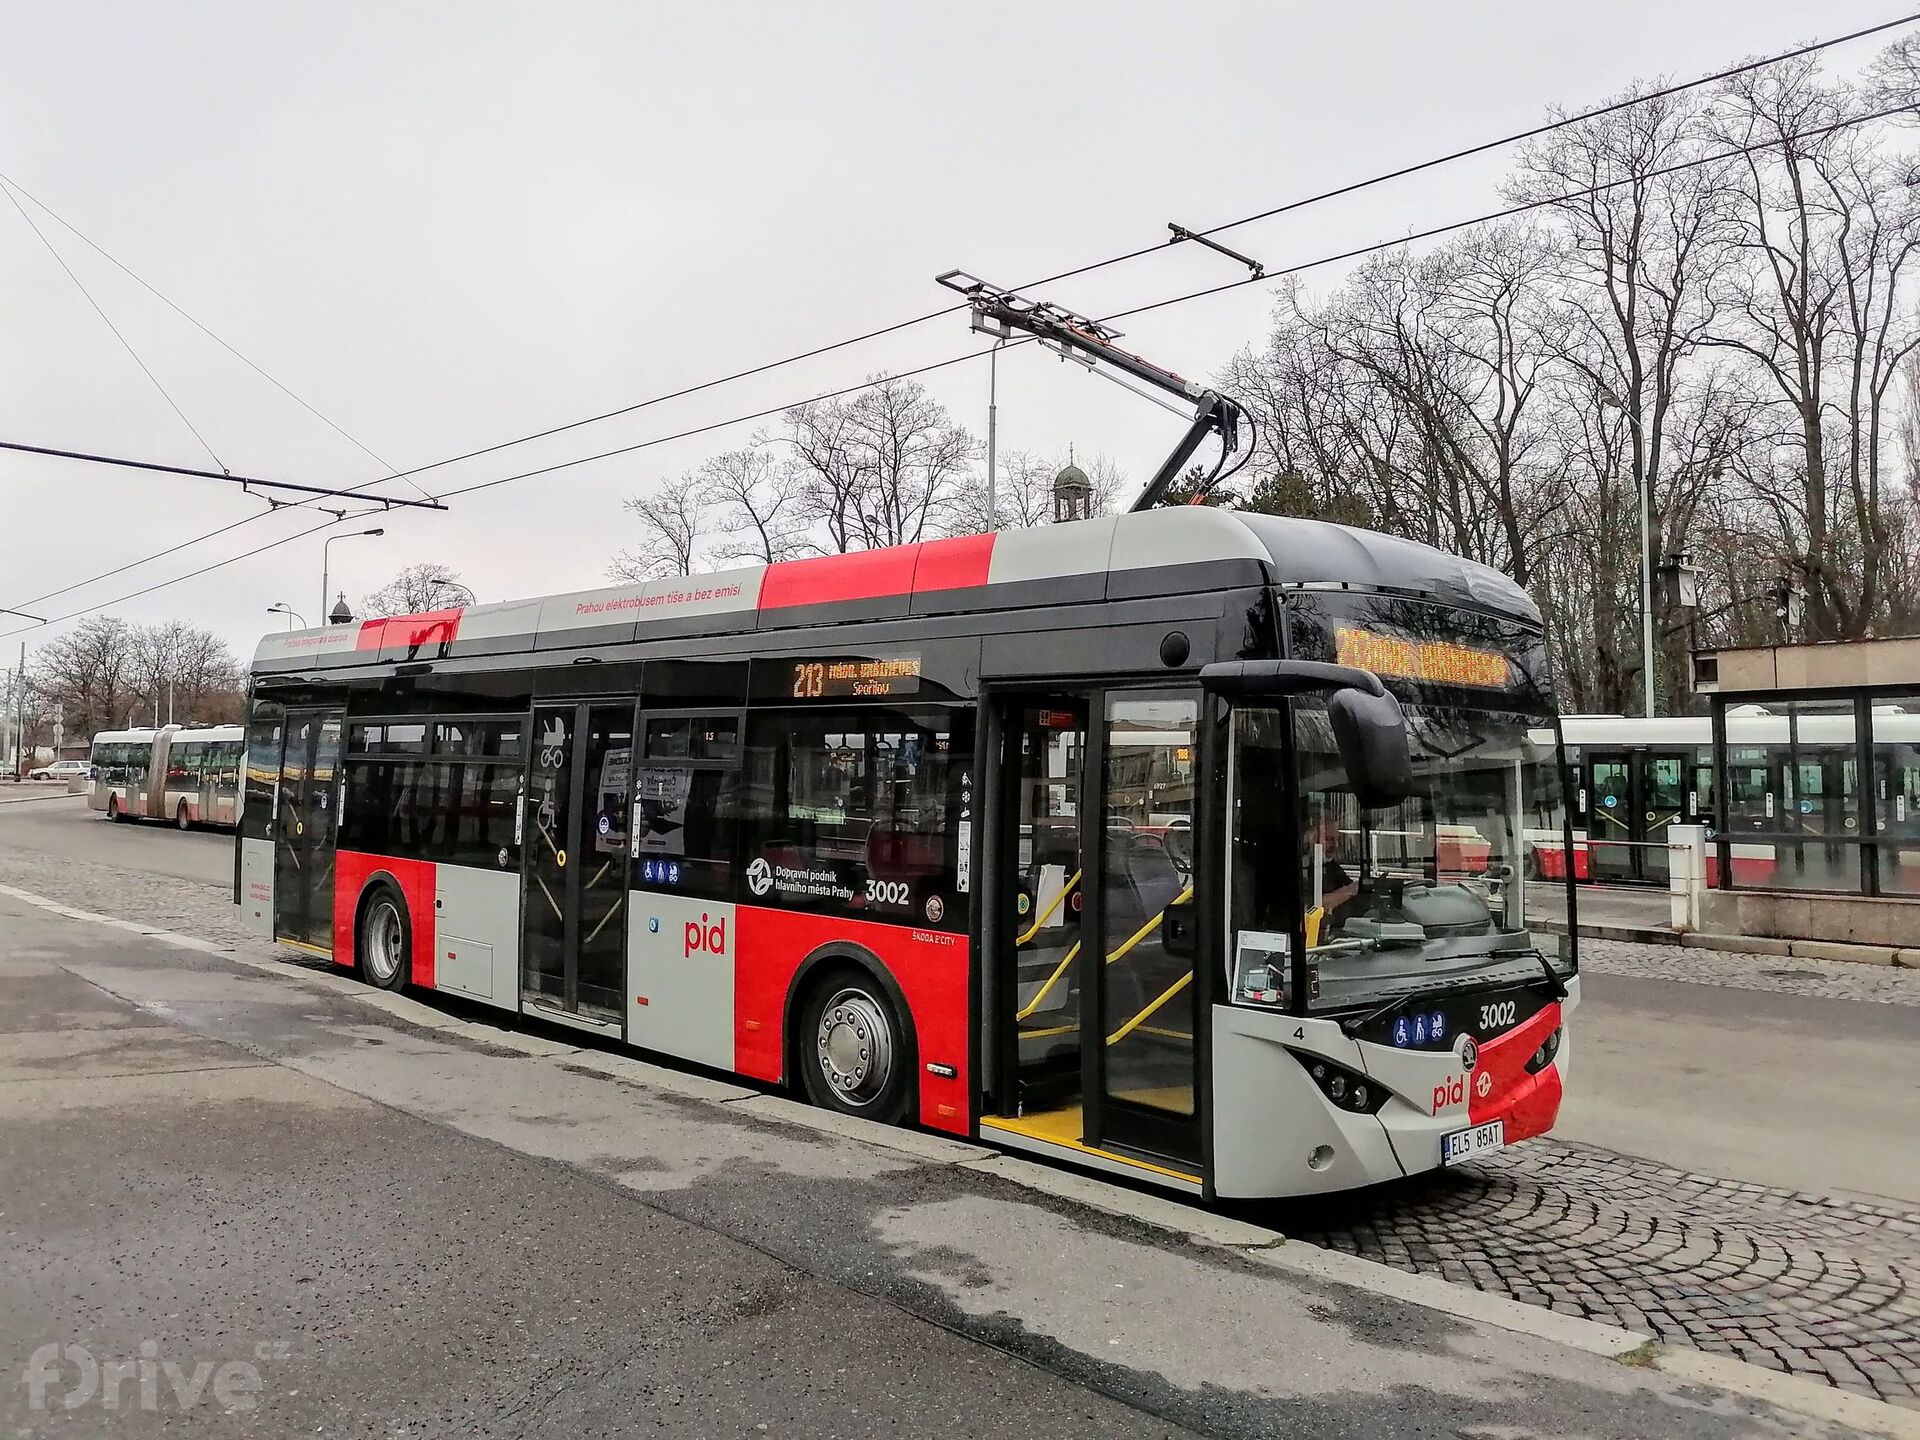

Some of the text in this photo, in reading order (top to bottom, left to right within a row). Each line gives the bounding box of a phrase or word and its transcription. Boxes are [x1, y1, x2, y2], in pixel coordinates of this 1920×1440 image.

[576, 582, 743, 615] Prahou elektrobusem tiše a bez emisí
[794, 663, 823, 697] 213
[852, 679, 890, 696] Spořilov
[775, 864, 837, 883] Dopravní podnik
[775, 878, 855, 901] hlavního města Prahy
[865, 879, 909, 905] 3002
[685, 912, 726, 959] pid
[911, 930, 934, 944] ŠKODA
[1480, 1000, 1516, 1030] 3002
[1293, 1026, 1305, 1041] 4
[1433, 1073, 1464, 1116] pid
[1452, 1124, 1499, 1156] EL5 85AT
